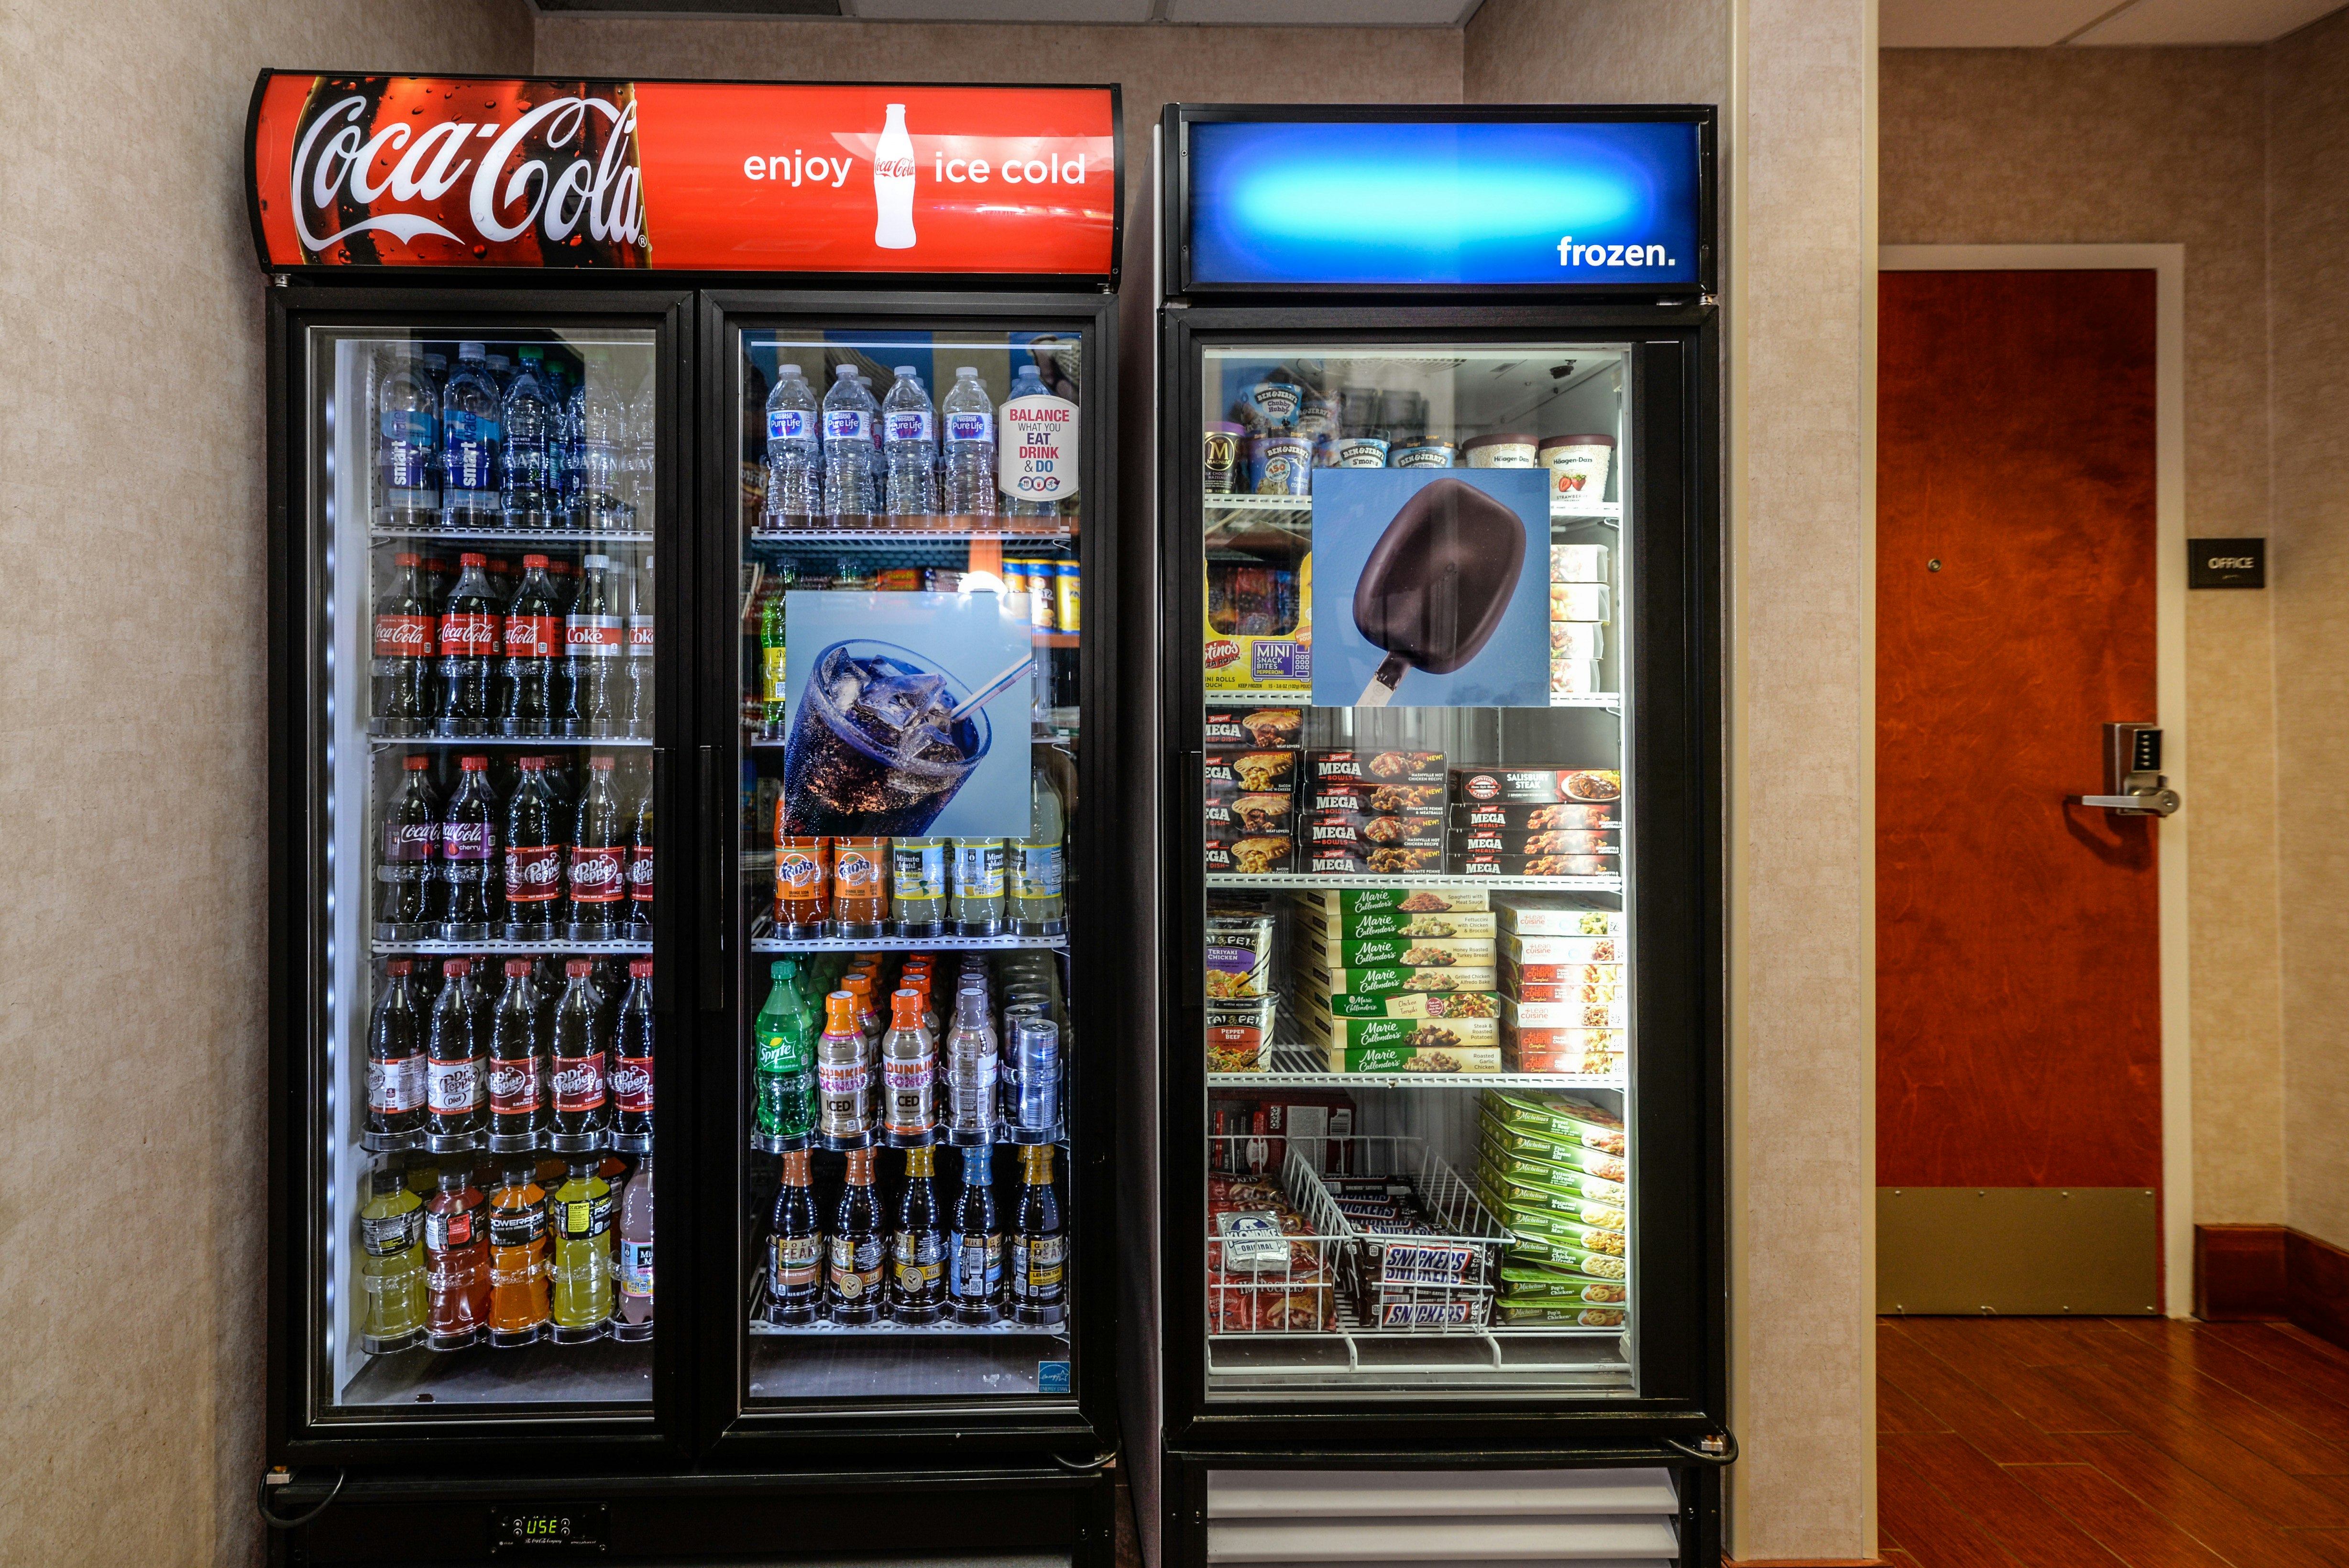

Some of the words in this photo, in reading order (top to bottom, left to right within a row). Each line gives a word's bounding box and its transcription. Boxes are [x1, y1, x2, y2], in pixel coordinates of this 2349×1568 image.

[292, 95, 644, 252] Coca-Cola
[744, 149, 853, 187] enjoy
[874, 157, 915, 178] Coca-Cola
[935, 152, 990, 183] ice
[1001, 153, 1085, 184] cold
[1557, 236, 1676, 266] frozen.
[1268, 401, 1291, 409] Chubby
[1010, 409, 1069, 421] BALANCE
[787, 419, 801, 429] Life
[845, 420, 859, 429] Life
[909, 422, 922, 431] Life
[1018, 423, 1042, 431] WHAT
[1044, 423, 1061, 431] YOU
[1027, 433, 1051, 446] EAT,
[1020, 447, 1059, 459] DRINK
[1210, 441, 1228, 460] M
[1024, 460, 1033, 472] &
[1036, 460, 1053, 472] DO
[1269, 463, 1285, 474] 150
[2208, 557, 2254, 570] OFFICE
[375, 623, 427, 643] Coca-Cola
[568, 628, 603, 644] Coke
[1257, 645, 1289, 658] MINI
[1218, 655, 1240, 665] ROLLS
[1318, 763, 1361, 776] MEGA
[1317, 797, 1359, 810] MEGA
[1313, 827, 1357, 840] MEGA
[541, 858, 555, 871] Dr
[589, 860, 605, 872] Dr
[782, 860, 813, 880] Fanta
[839, 859, 870, 879] Fanta
[1312, 859, 1355, 872] MEGA
[580, 863, 614, 883] Pepper
[1355, 891, 1390, 904] Marie
[1355, 899, 1392, 913] Callender's
[1356, 915, 1393, 929] Marie
[1356, 924, 1396, 938] Callender's
[1356, 942, 1393, 955] Marie
[760, 1044, 791, 1063] Sprite
[448, 1096, 462, 1105] Diet
[827, 1100, 851, 1112] ICED
[782, 1239, 815, 1248] GOLD
[1034, 1239, 1062, 1249] GOLD
[1387, 1249, 1466, 1271] SNICKERS
[527, 1520, 557, 1534] USE
